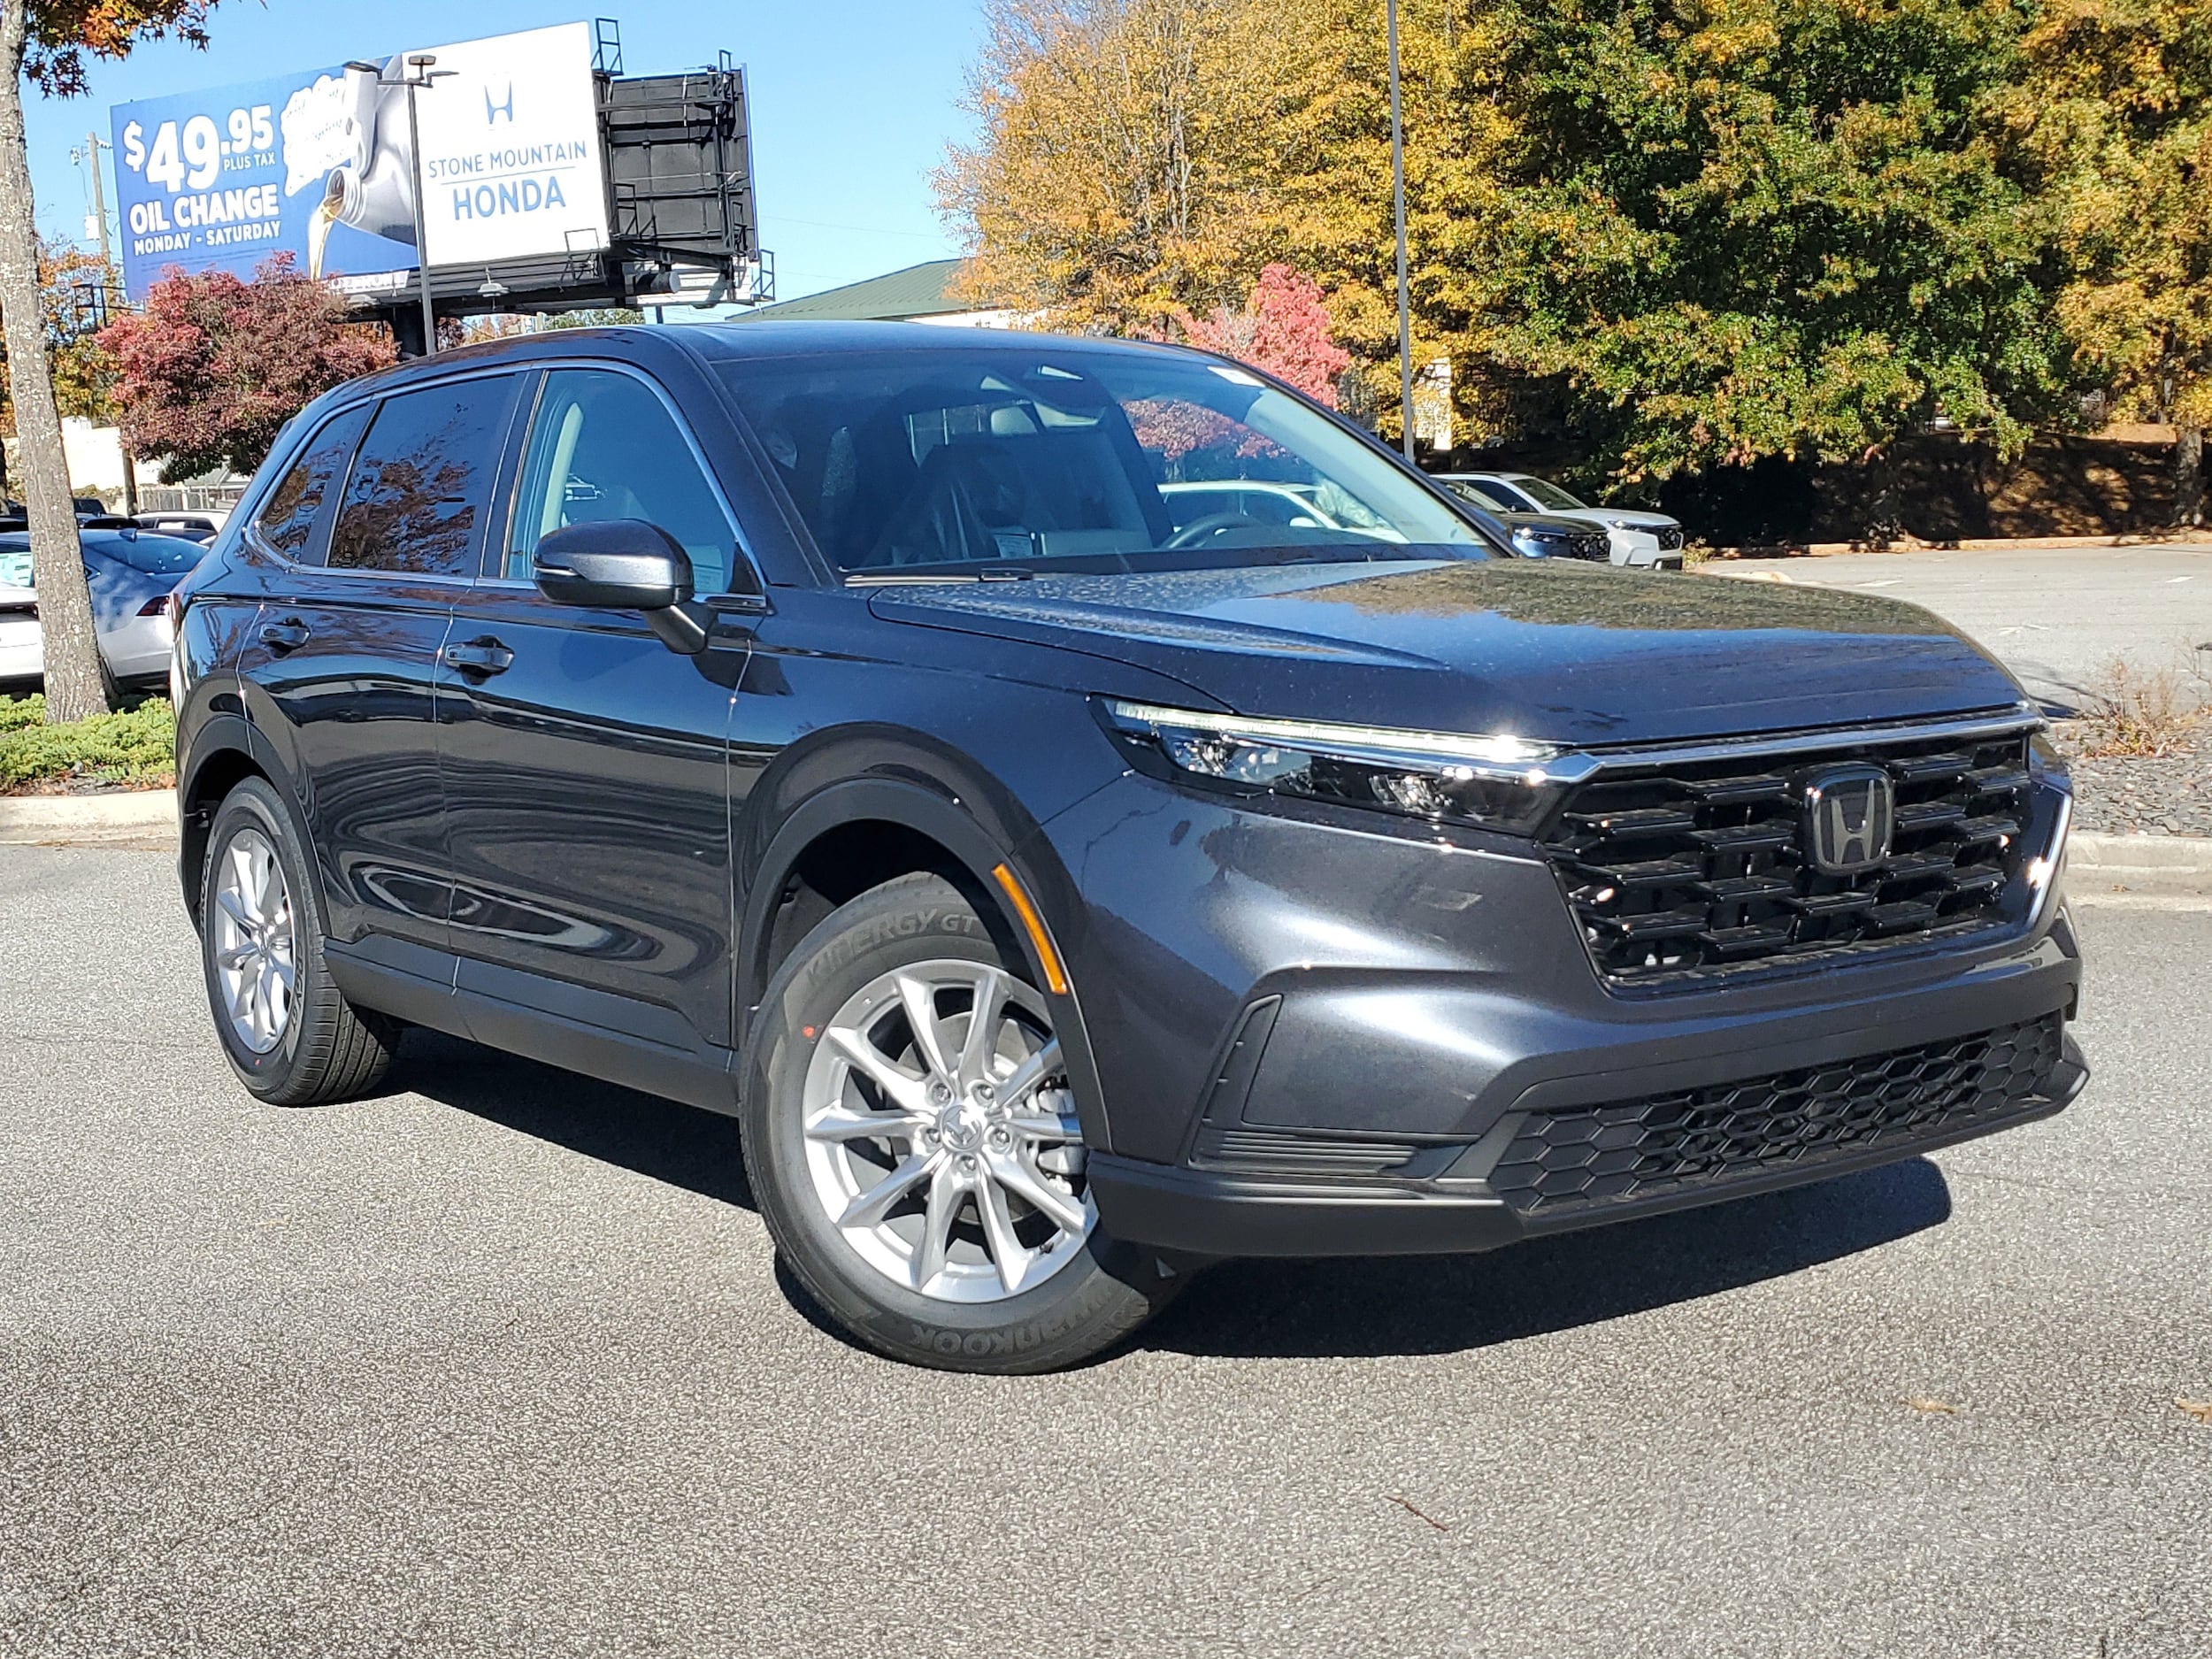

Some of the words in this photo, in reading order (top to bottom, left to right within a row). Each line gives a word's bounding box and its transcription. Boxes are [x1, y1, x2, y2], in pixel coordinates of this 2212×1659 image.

[223, 154, 251, 172] PLUS
[255, 151, 276, 167] TAX
[428, 153, 484, 178] STONE
[489, 140, 587, 170] MOUNTAIN
[129, 201, 170, 234] OIL
[173, 184, 280, 228] CHANGE
[452, 176, 566, 220] HONDA
[134, 232, 192, 256] MONDAY
[206, 221, 281, 246] SATURDAY
[806, 909, 938, 986] KINERGY
[941, 913, 979, 933] GT
